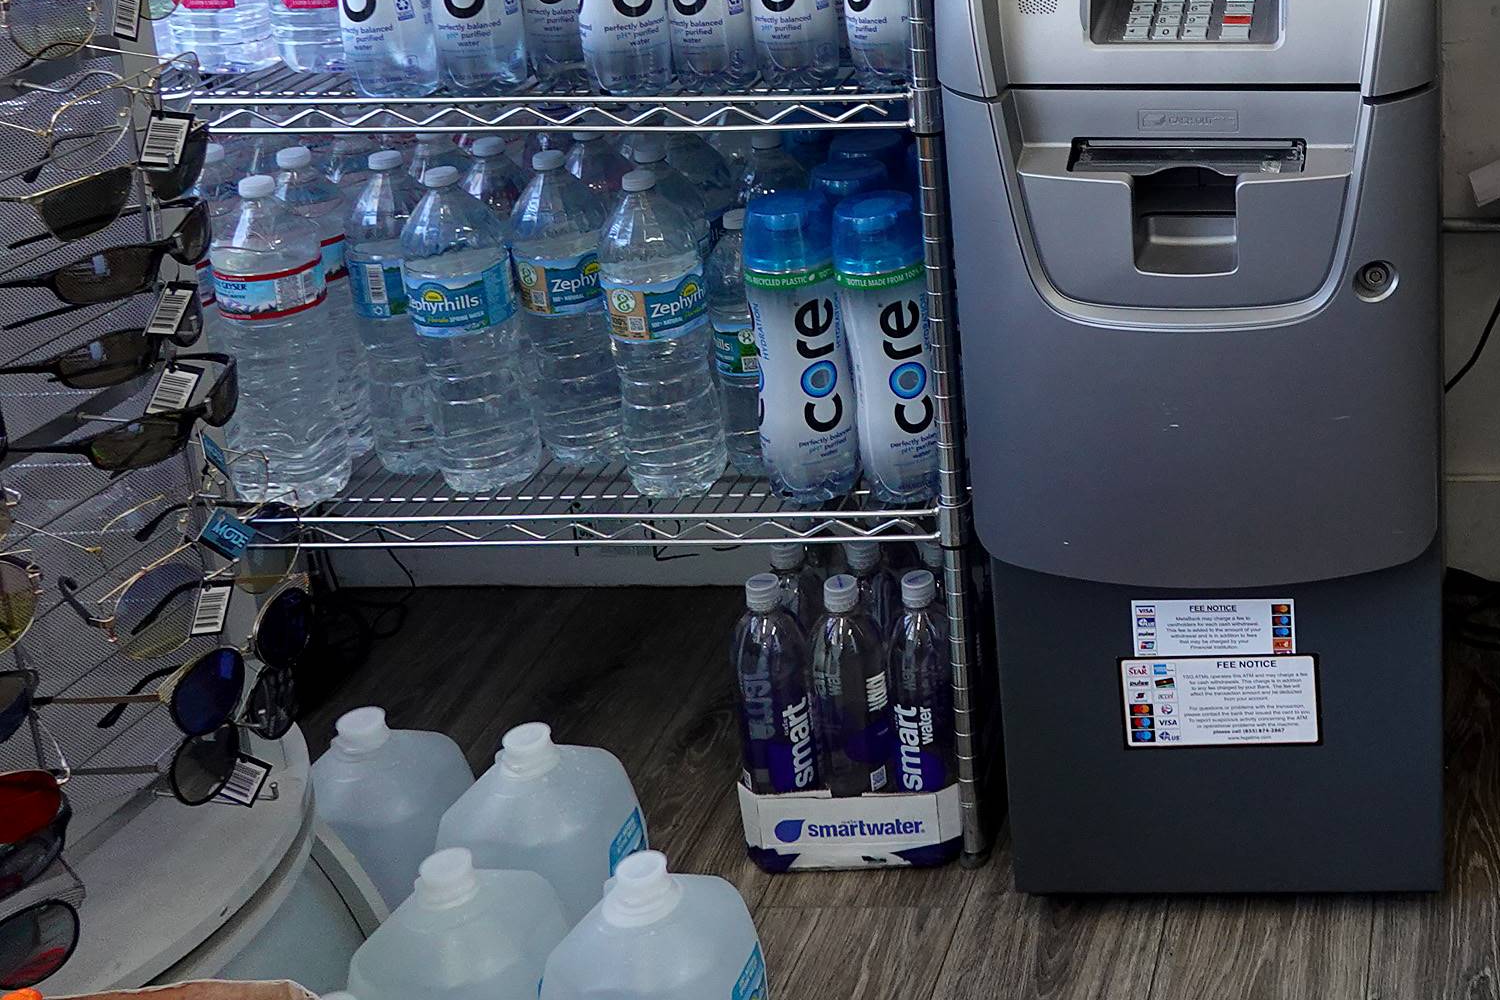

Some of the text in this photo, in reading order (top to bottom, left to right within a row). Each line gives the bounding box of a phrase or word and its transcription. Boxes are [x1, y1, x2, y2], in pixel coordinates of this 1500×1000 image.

[794, 297, 843, 433] core
[879, 299, 934, 434] core
[213, 519, 249, 549] MODE
[1207, 604, 1237, 612] NOTICE
[1216, 660, 1277, 669] FEE NOTICE
[782, 696, 813, 788] smart
[919, 706, 935, 745] water
[893, 703, 924, 791] smart
[808, 817, 924, 838] smartwater
